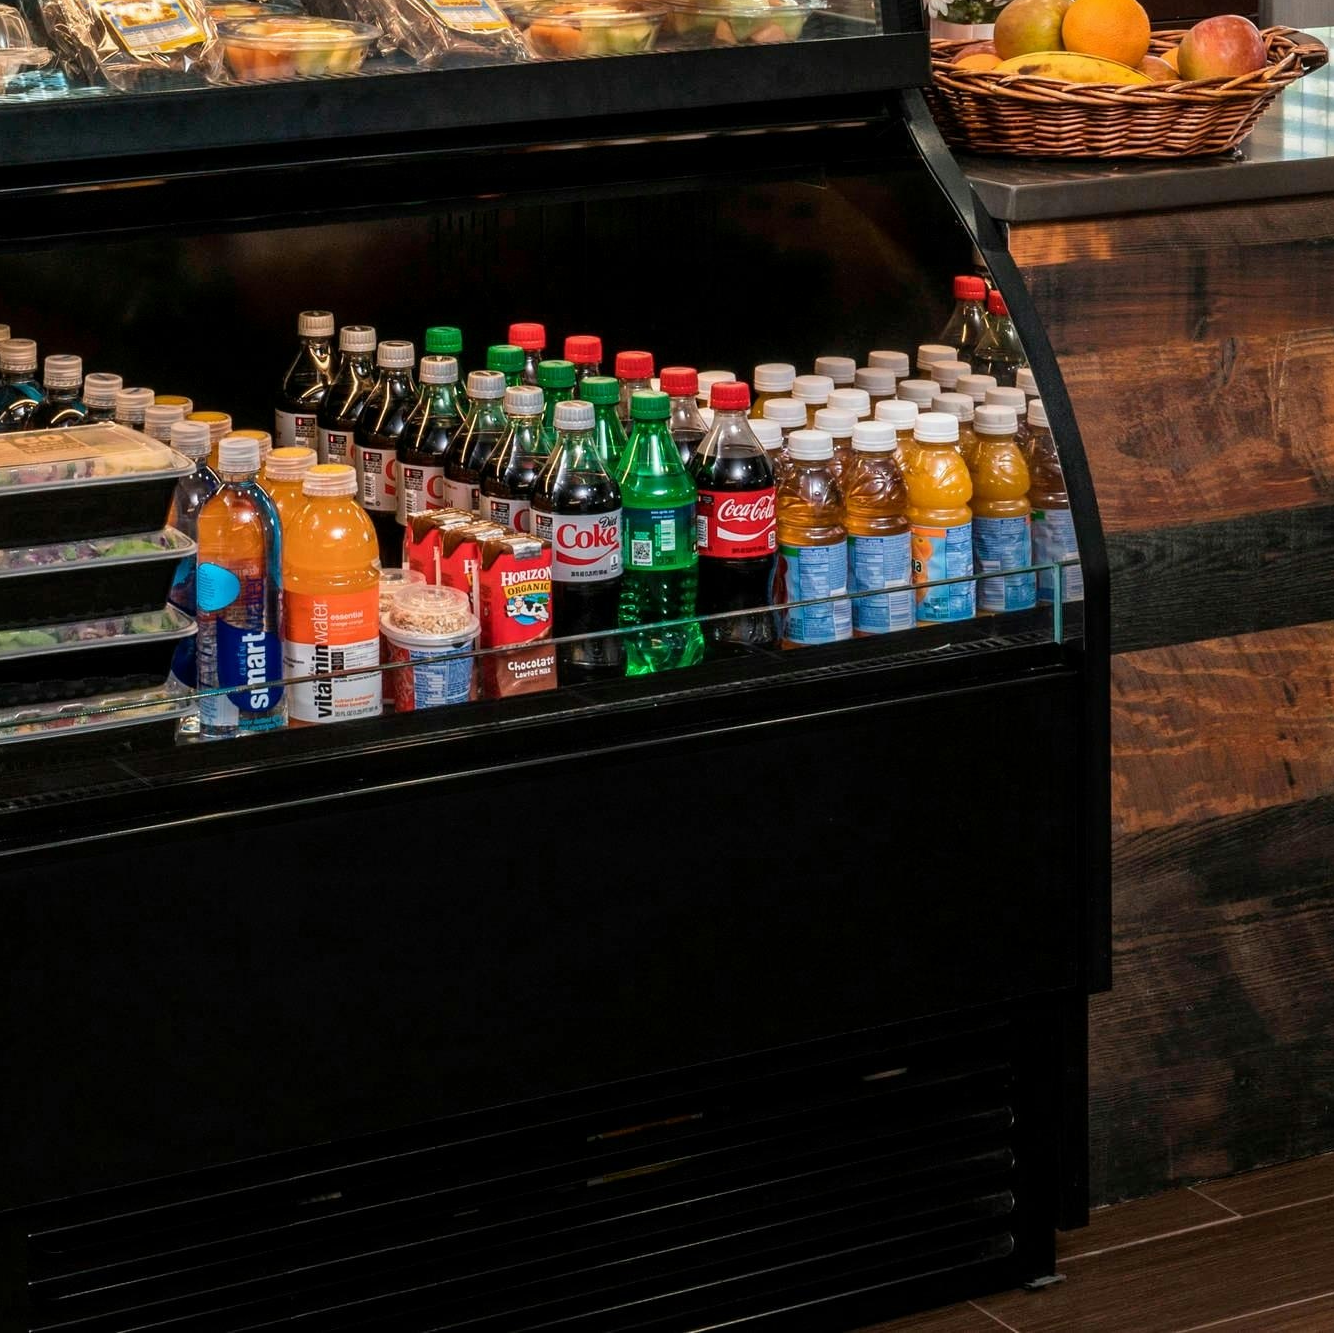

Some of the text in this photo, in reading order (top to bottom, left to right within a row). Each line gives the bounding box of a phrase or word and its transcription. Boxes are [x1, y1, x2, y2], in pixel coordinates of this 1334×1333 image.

[557, 524, 617, 549] Coke
[507, 582, 549, 595] ORGANIC
[508, 655, 554, 671] Chocolate
